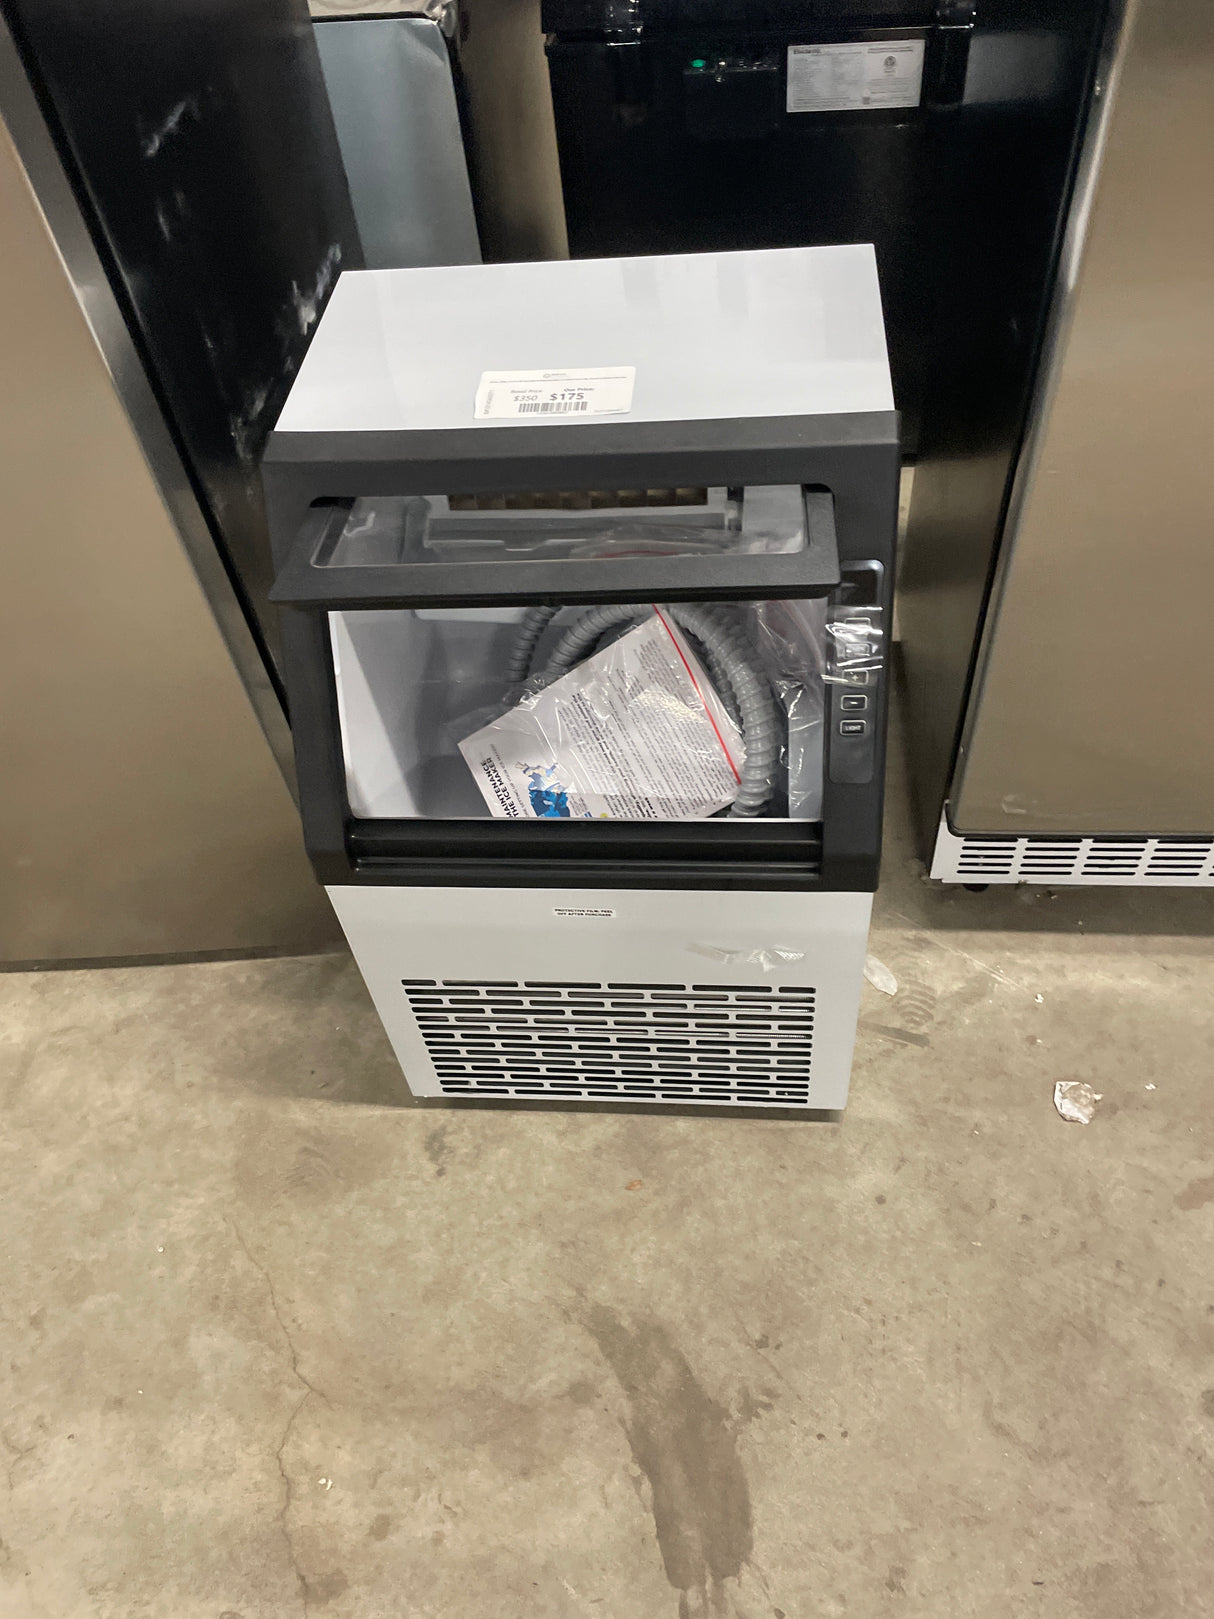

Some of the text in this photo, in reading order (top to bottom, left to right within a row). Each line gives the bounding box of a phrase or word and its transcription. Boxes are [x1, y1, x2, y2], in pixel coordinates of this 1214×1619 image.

[550, 392, 584, 400] $175
[480, 760, 511, 817] MAINTENANCE
[485, 756, 519, 816] THE ICE MAKER
